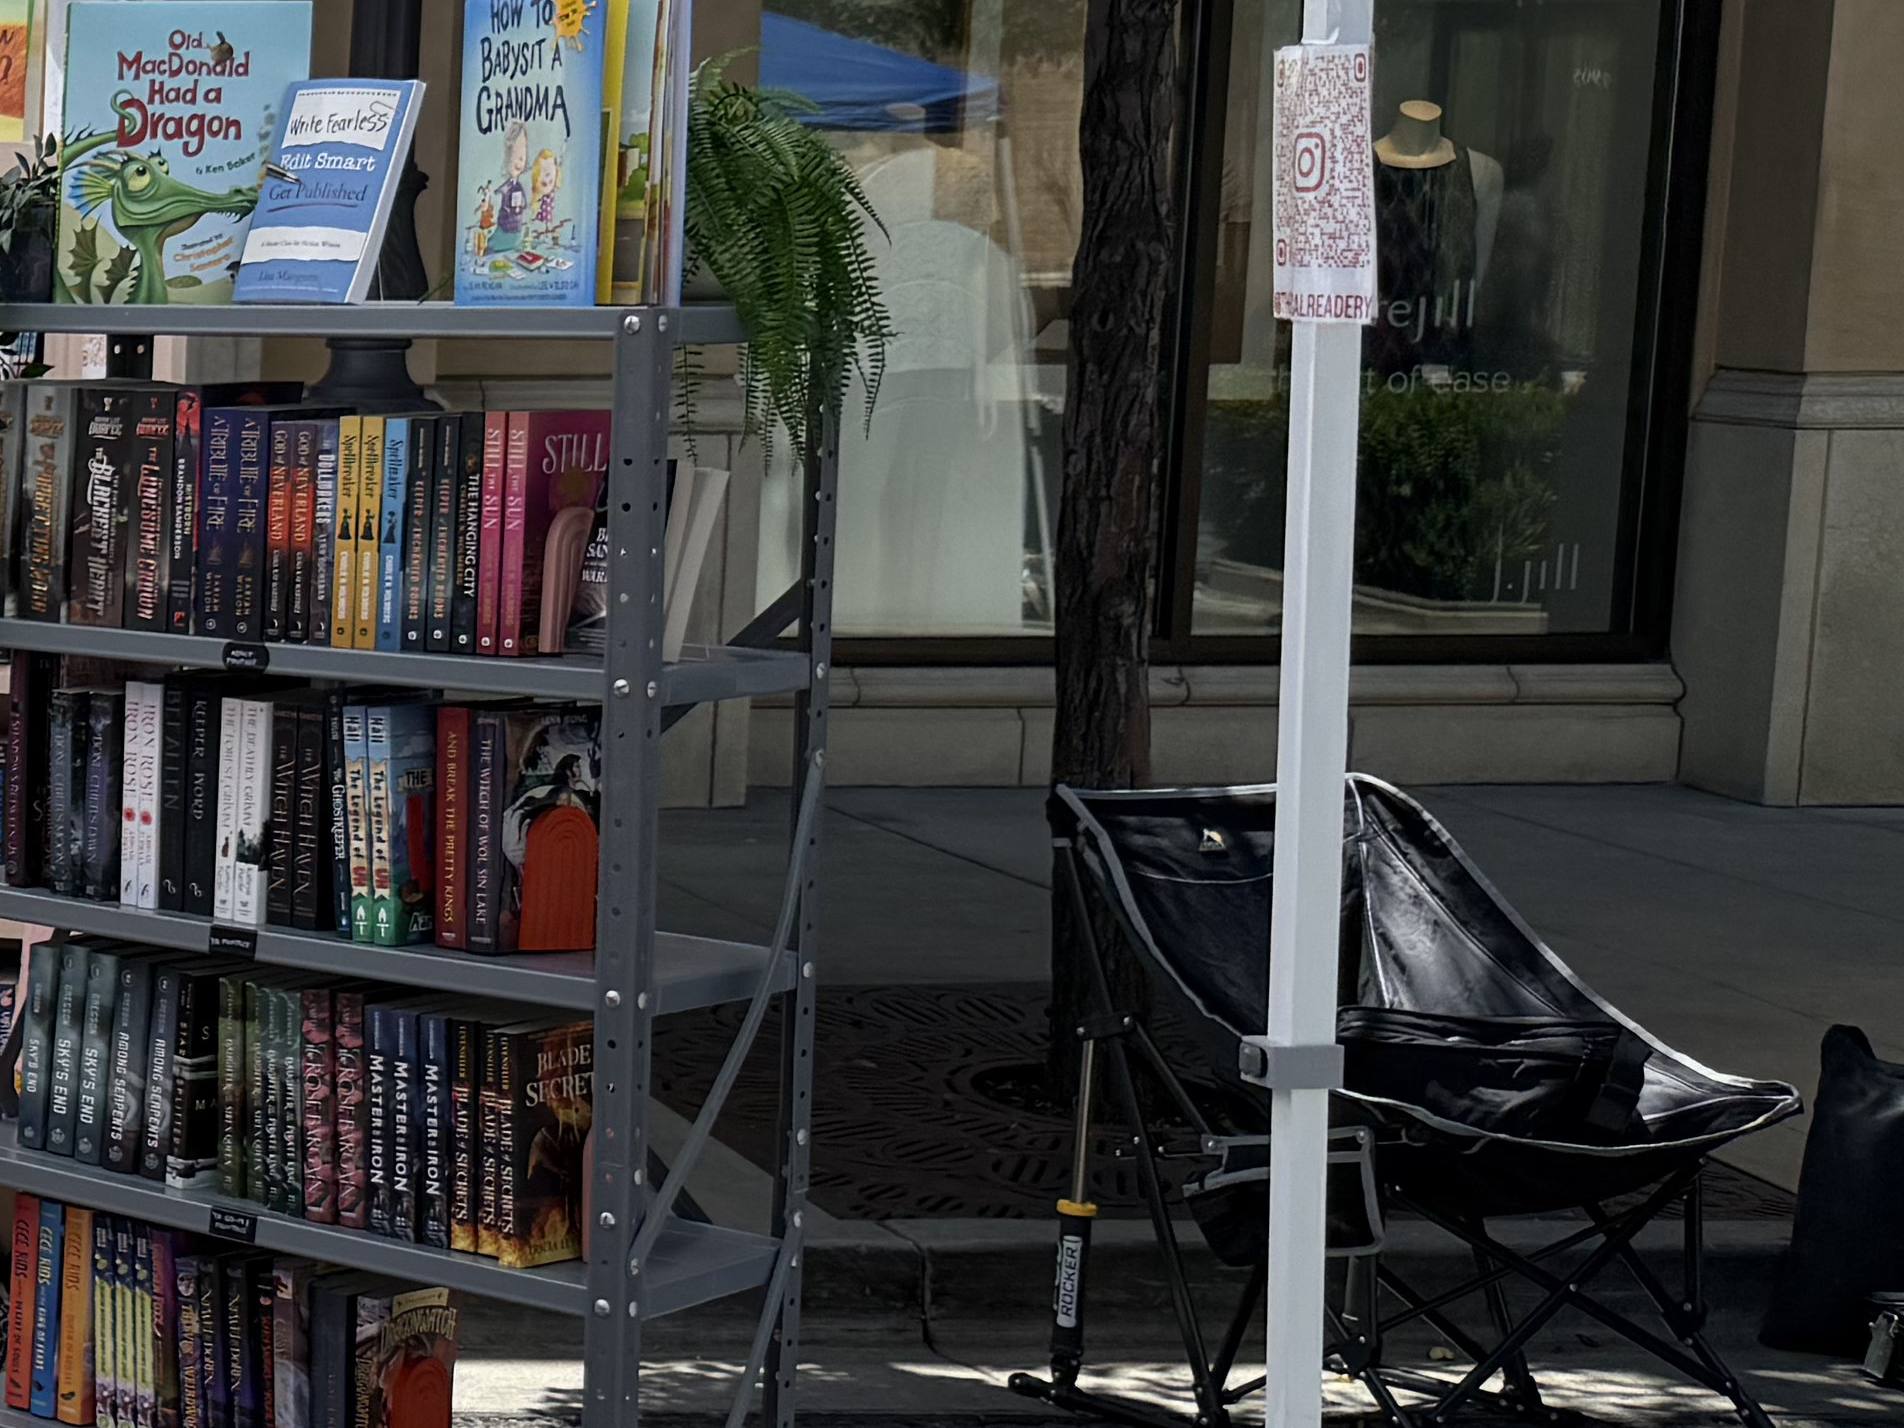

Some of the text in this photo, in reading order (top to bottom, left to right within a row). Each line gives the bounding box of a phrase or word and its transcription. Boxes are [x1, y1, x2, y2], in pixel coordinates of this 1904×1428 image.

[168, 28, 204, 51] Old
[480, 37, 563, 84] BABYSIT A
[117, 49, 251, 82] MacDonald
[147, 78, 223, 106] Had a
[475, 84, 571, 138] GRANDMA
[116, 97, 242, 159] Dragon
[289, 109, 390, 138] Write Fearless
[205, 162, 225, 175] Ken
[226, 151, 258, 173] Baker
[279, 152, 377, 173] Edit Smart
[268, 182, 369, 202] Get Published
[1387, 367, 1421, 394] of
[1432, 370, 1512, 395] ease
[341, 435, 357, 498] Spellbreaker
[364, 434, 380, 498] Spellbreaker
[484, 428, 501, 472] STILL
[508, 429, 524, 473] STILL
[542, 433, 607, 475] STILL
[137, 464, 161, 554] LONESOME
[173, 458, 186, 559] BRANDON SANDERSON
[483, 494, 498, 528] SUN
[506, 496, 522, 531] SUN
[463, 473, 480, 597] THE HANGING CITY
[136, 558, 157, 620] CROWN
[246, 707, 257, 727] THE
[345, 716, 361, 742] Hall
[371, 717, 385, 743] Hall
[125, 701, 139, 796] IRON ROSE
[141, 705, 156, 798] IRON ROSE
[192, 700, 207, 820] KEEPER WORD
[245, 733, 257, 782] DEATHLY
[350, 769, 361, 788] The
[373, 770, 385, 791] The
[404, 769, 431, 789] THE
[348, 794, 362, 841] Legend
[372, 797, 386, 843] Legend
[444, 732, 459, 923] AND BREAK THE PRETTY KINGS
[476, 739, 492, 924] THE WITCH OF WOL SIN LAKE
[352, 846, 363, 859] of
[375, 848, 386, 861] of
[55, 1039, 71, 1080] SKY'S
[82, 1047, 98, 1090] SKY'S
[536, 1044, 592, 1080] BLADE
[52, 1085, 68, 1114] END
[79, 1094, 94, 1124] END
[110, 1032, 130, 1140] AMONG SERPENTS
[147, 1038, 167, 1148] AMONG SERPENTS
[338, 1065, 356, 1198] ROSE BARGAIN
[369, 1055, 384, 1183] MASTER IRON
[394, 1061, 409, 1192] MASTER IRON
[425, 1064, 440, 1195] MASTER IRON
[305, 1115, 323, 1193] BARGAIN
[480, 1091, 498, 1225] BLADE SECRETS
[65, 1232, 82, 1291] CECE RIOS
[1061, 1245, 1077, 1318] ROCKER
